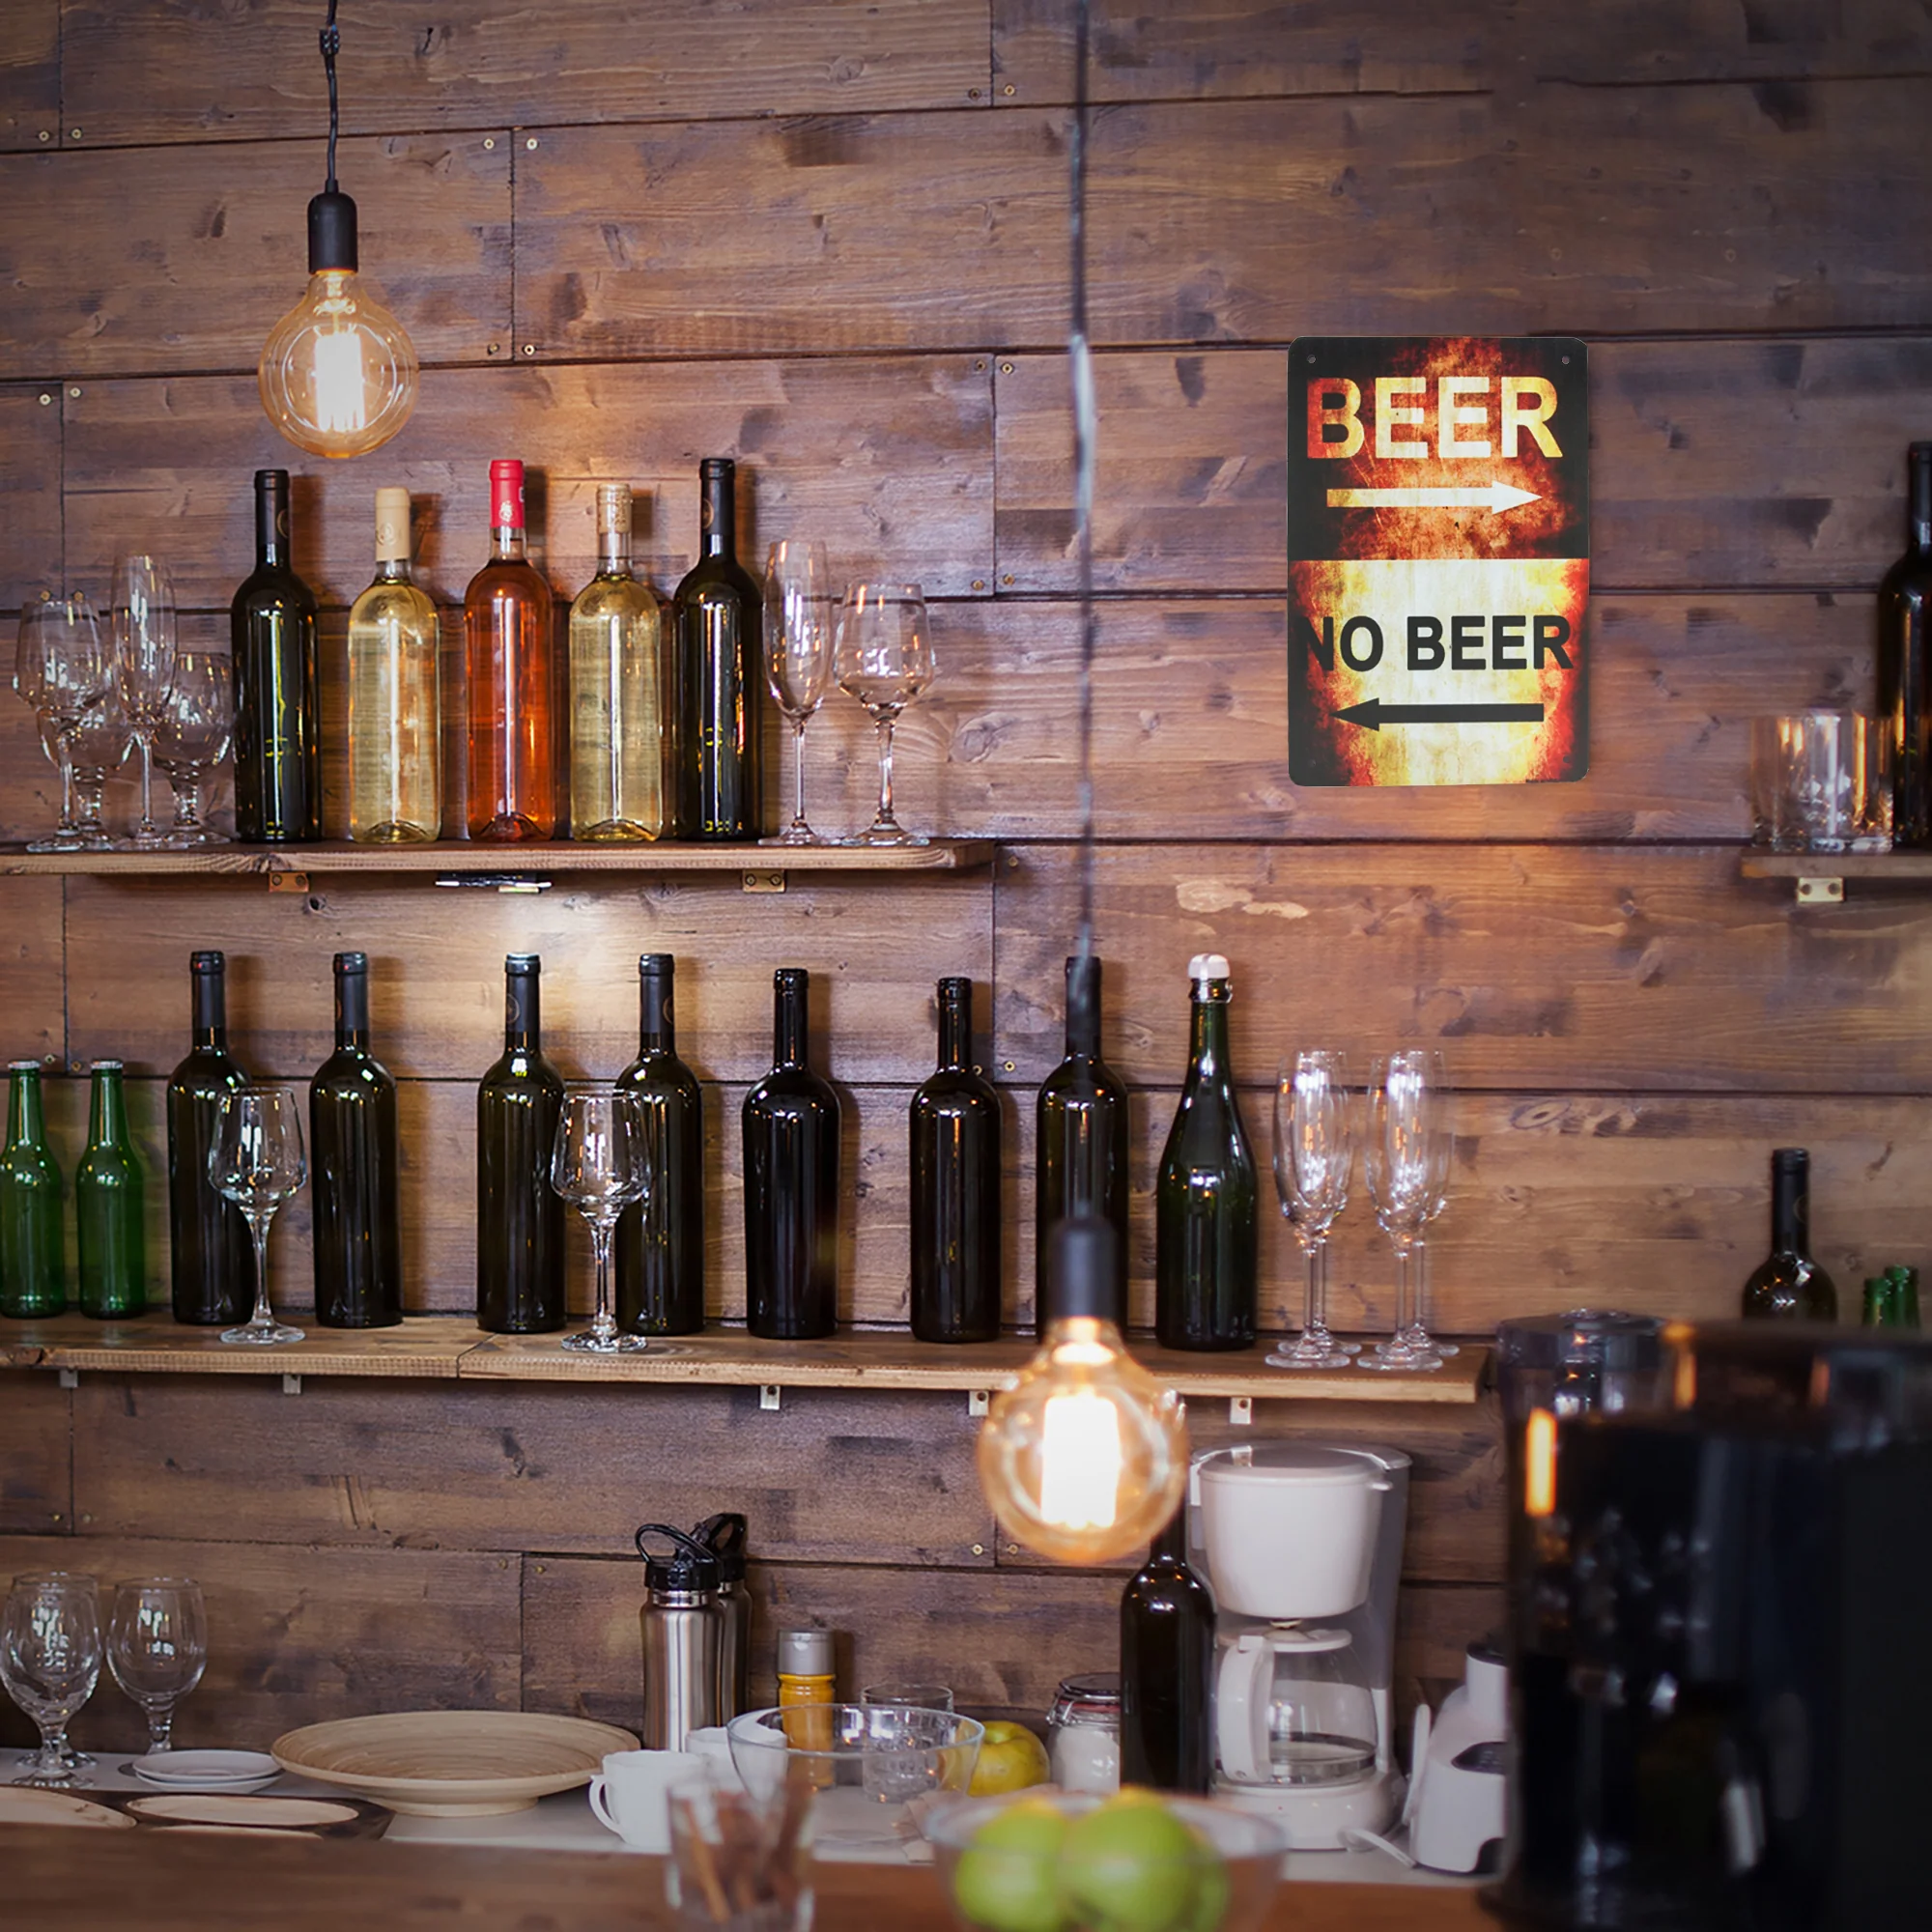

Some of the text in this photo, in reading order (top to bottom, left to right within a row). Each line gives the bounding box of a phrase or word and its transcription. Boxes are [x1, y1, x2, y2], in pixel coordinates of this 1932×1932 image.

[1307, 377, 1563, 459] BEER
[1298, 615, 1574, 671] NO BEER
